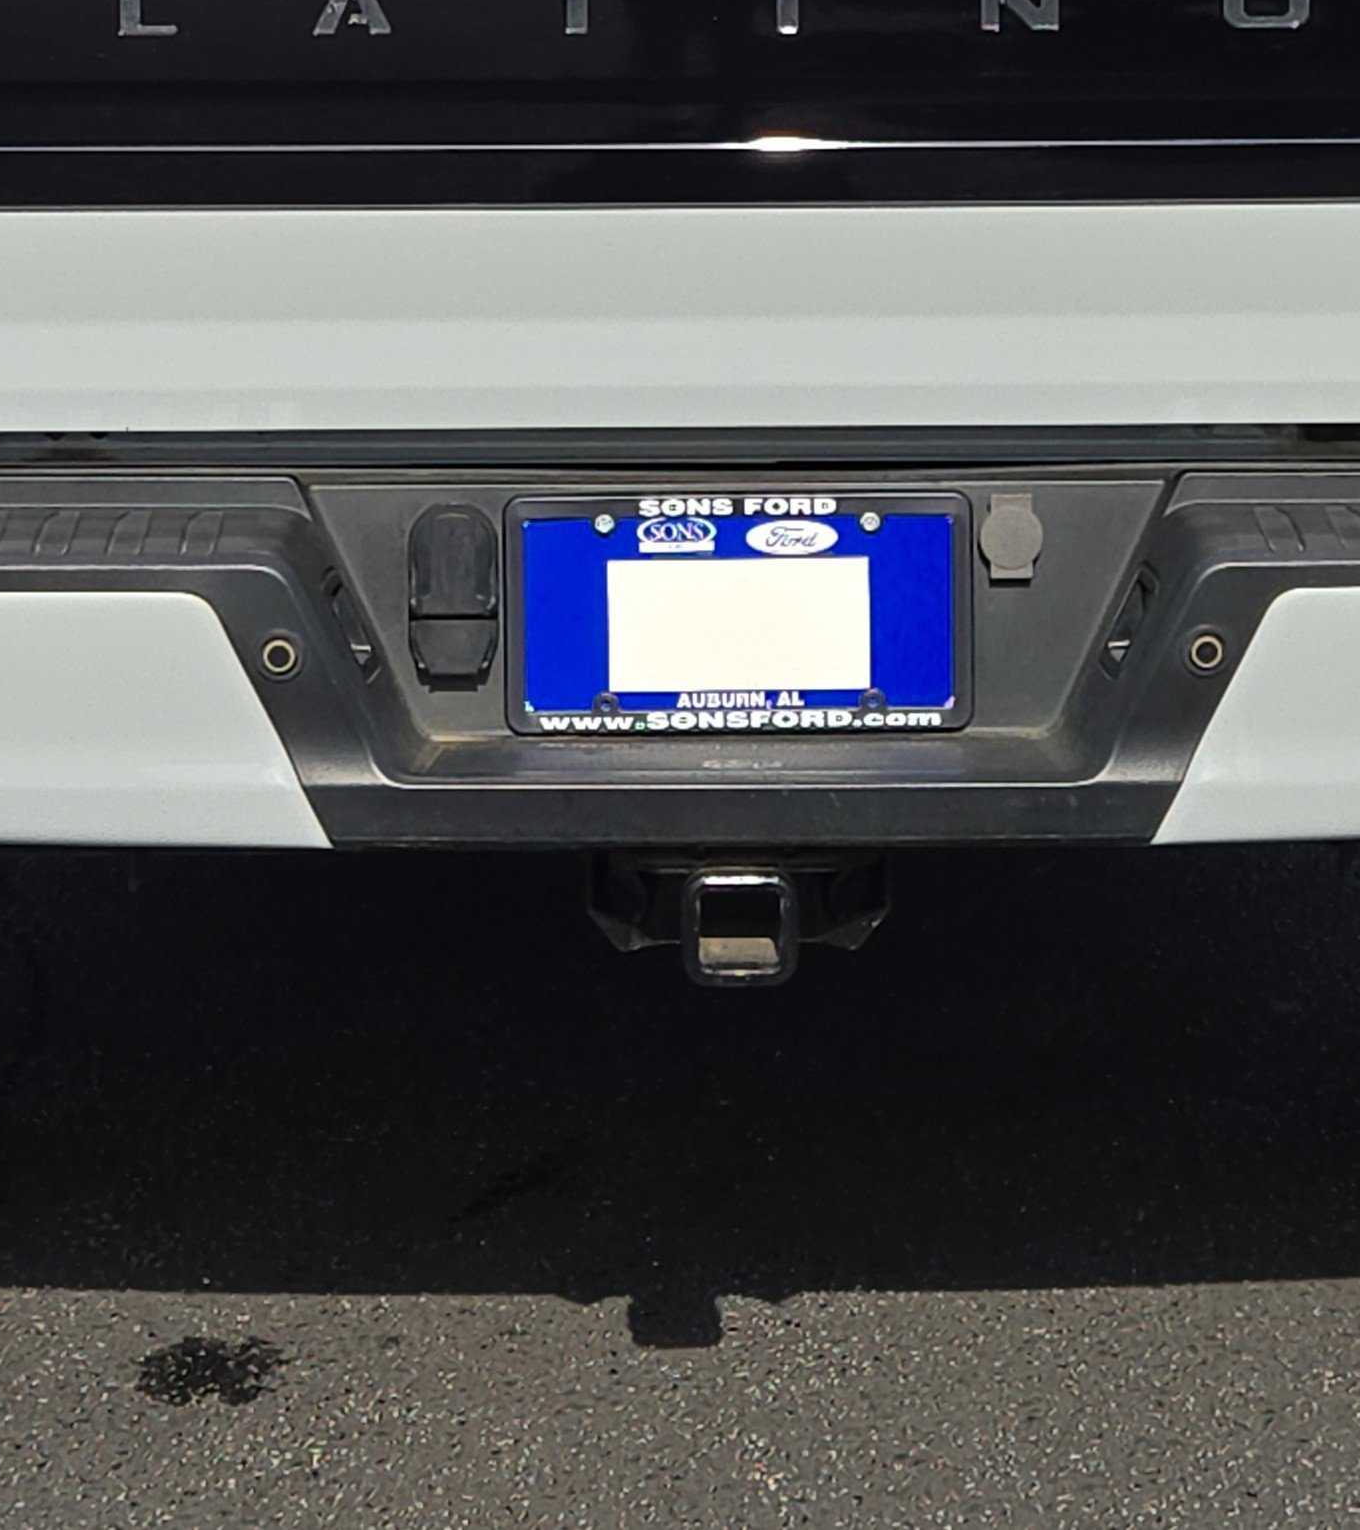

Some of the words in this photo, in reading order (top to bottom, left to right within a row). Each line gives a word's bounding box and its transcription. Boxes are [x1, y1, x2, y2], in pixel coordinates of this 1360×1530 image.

[639, 498, 733, 517] SONS
[744, 498, 837, 516] FORD
[648, 522, 705, 543] SONS
[765, 526, 818, 548] Ford
[776, 690, 805, 707] AL
[540, 710, 942, 731] www.SONSFORD.com
